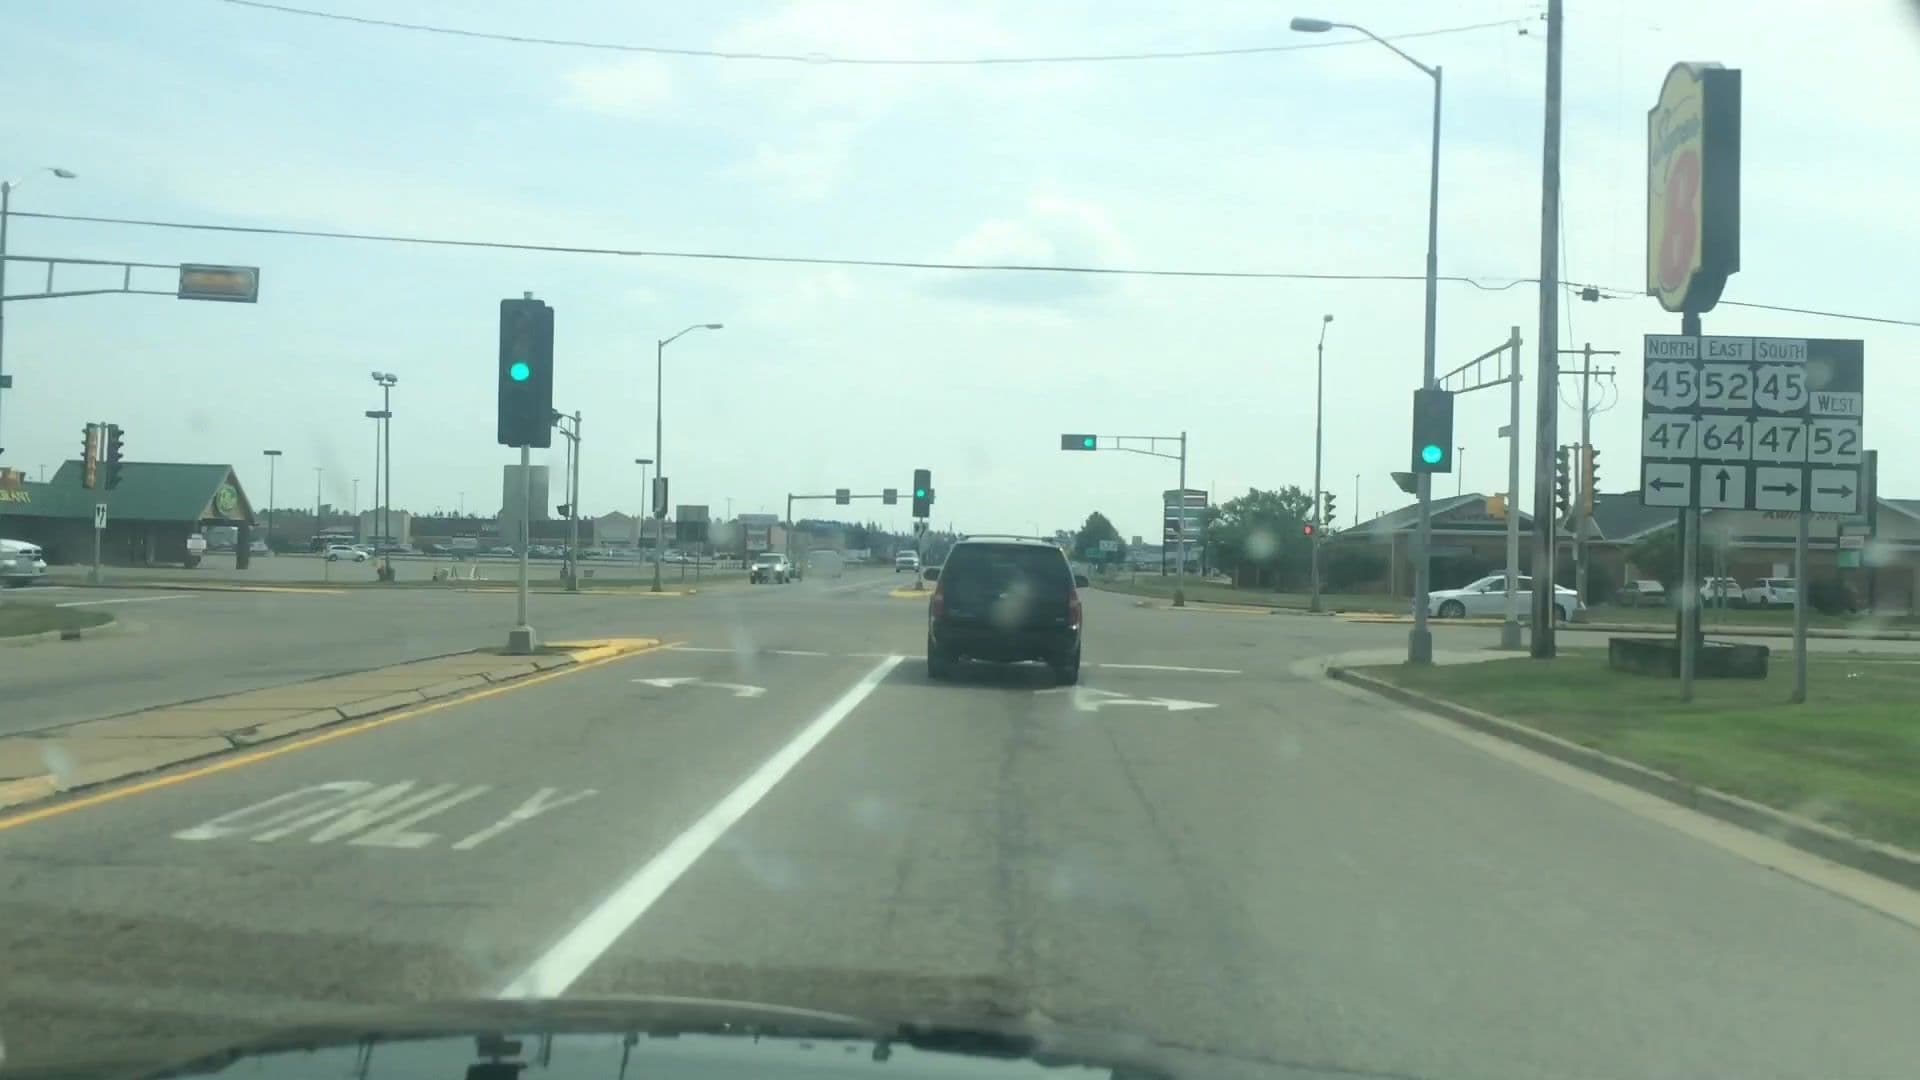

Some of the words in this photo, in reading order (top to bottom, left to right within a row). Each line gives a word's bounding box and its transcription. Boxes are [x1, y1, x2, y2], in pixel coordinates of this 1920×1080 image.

[1649, 340, 1695, 357] NORTH
[1709, 340, 1744, 357] EAST
[1759, 342, 1805, 359] SOUTH
[1651, 370, 1692, 398] 45
[1705, 372, 1749, 401] 52
[1762, 373, 1802, 401] 45
[1817, 395, 1856, 412] WEST
[1649, 423, 1691, 449] 47
[1703, 424, 1745, 451] 64
[1759, 426, 1801, 453] 47
[1813, 427, 1858, 456] 52
[171, 778, 600, 850] ONLY
